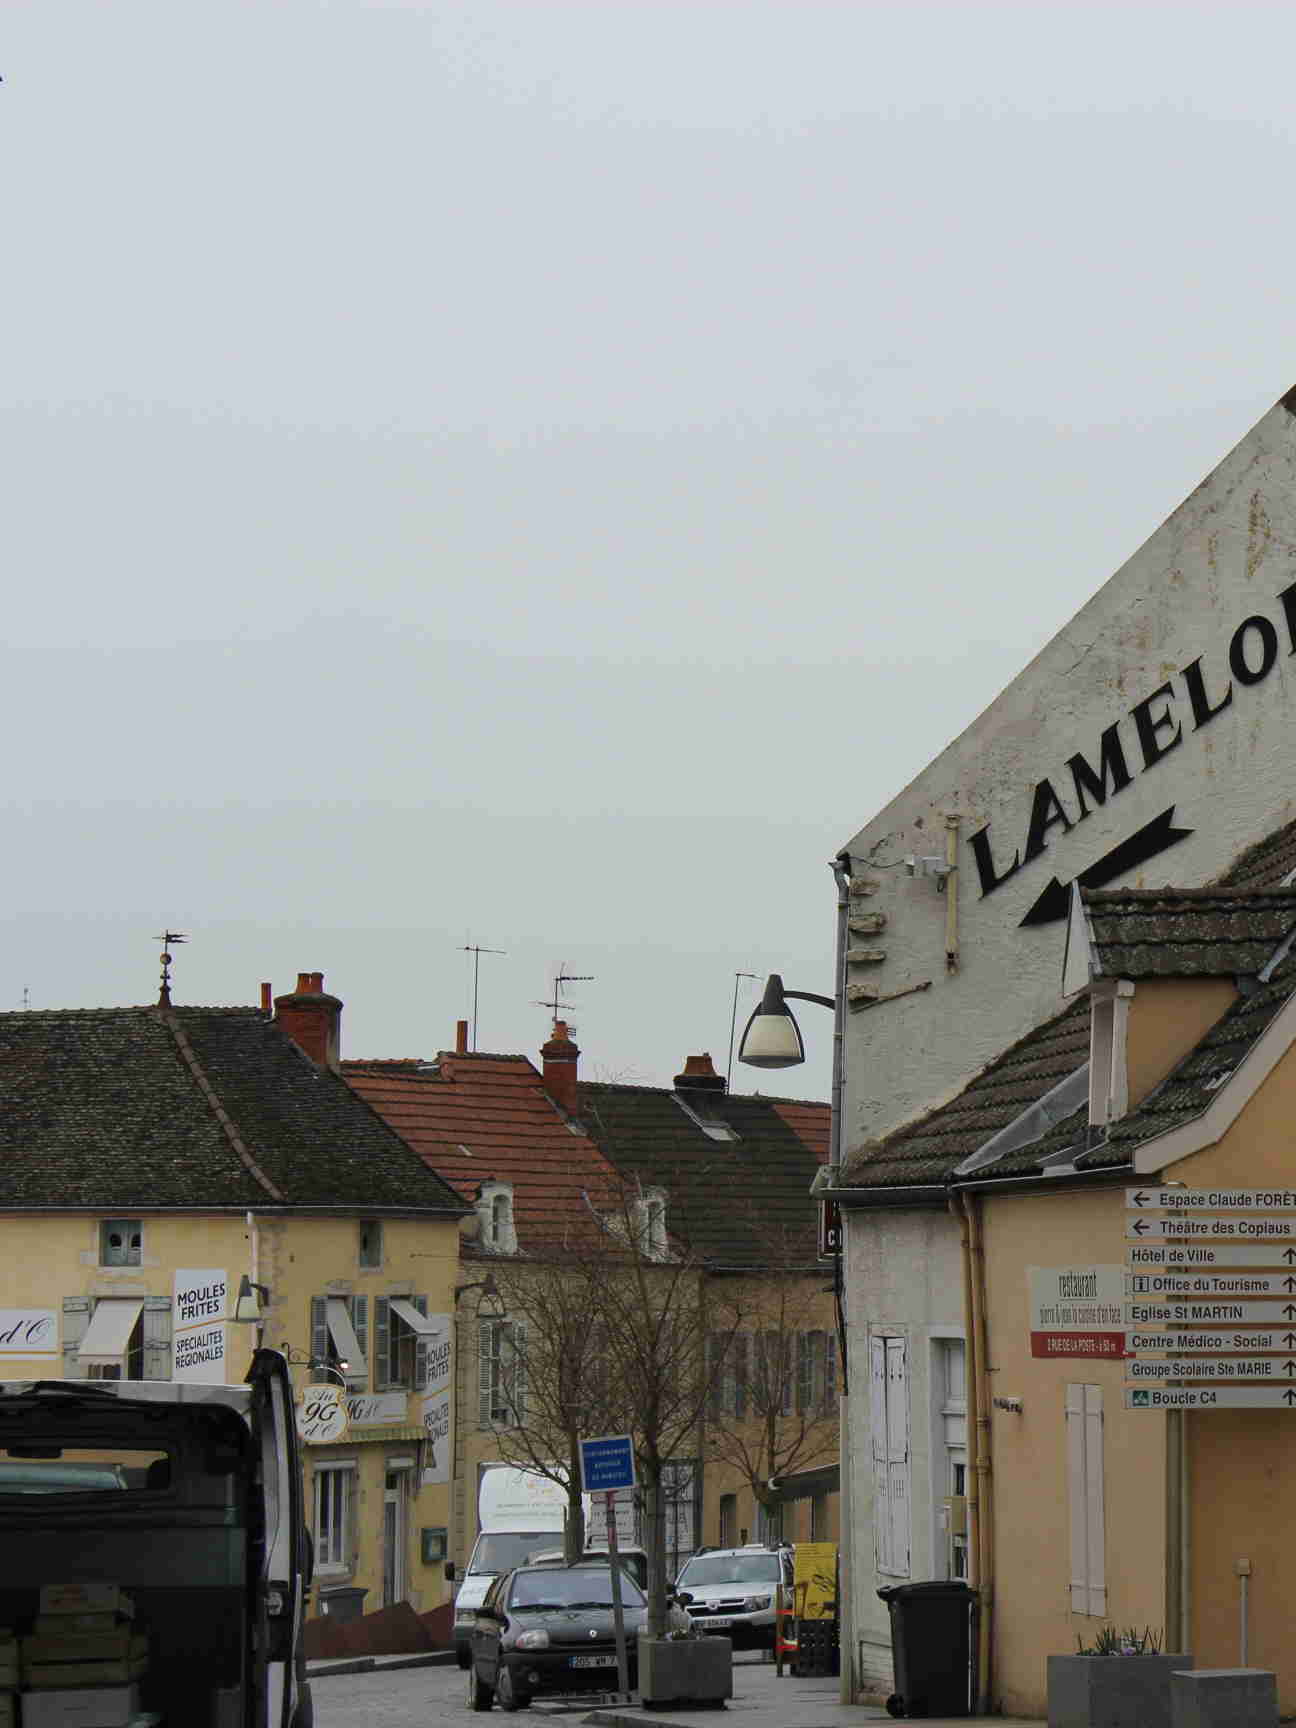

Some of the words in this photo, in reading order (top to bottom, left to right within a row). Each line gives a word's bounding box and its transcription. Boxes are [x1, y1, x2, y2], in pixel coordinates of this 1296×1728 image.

[1160, 1193, 1205, 1208] Espace
[1208, 1193, 1252, 1206] Claude
[1212, 1221, 1234, 1234] des
[1132, 1248, 1165, 1262] Hôtel
[1168, 1250, 1185, 1262] de
[1187, 1249, 1215, 1262] Ville
[1059, 1270, 1097, 1297] restaurant
[1153, 1279, 1191, 1291] Office
[1193, 1279, 1210, 1291] du
[1211, 1279, 1270, 1291] Tourisme
[178, 1283, 225, 1306] MOULES
[181, 1299, 220, 1320] FRITES
[1132, 1306, 1171, 1322] Eglise
[1174, 1306, 1188, 1319] St
[1191, 1306, 1243, 1319] MARTIN
[177, 1331, 223, 1353] SPECIALITES
[1132, 1335, 1174, 1348] Centre
[1178, 1334, 1222, 1348] Médico
[1233, 1334, 1273, 1348] Social
[176, 1346, 224, 1368] REGIONALES
[1132, 1363, 1170, 1378] Groupe
[1172, 1363, 1215, 1376] Scolaire
[1217, 1363, 1235, 1376] Ste
[1237, 1363, 1273, 1375] MARIE
[1152, 1392, 1197, 1405] Boucle
[1199, 1392, 1217, 1405] C4
